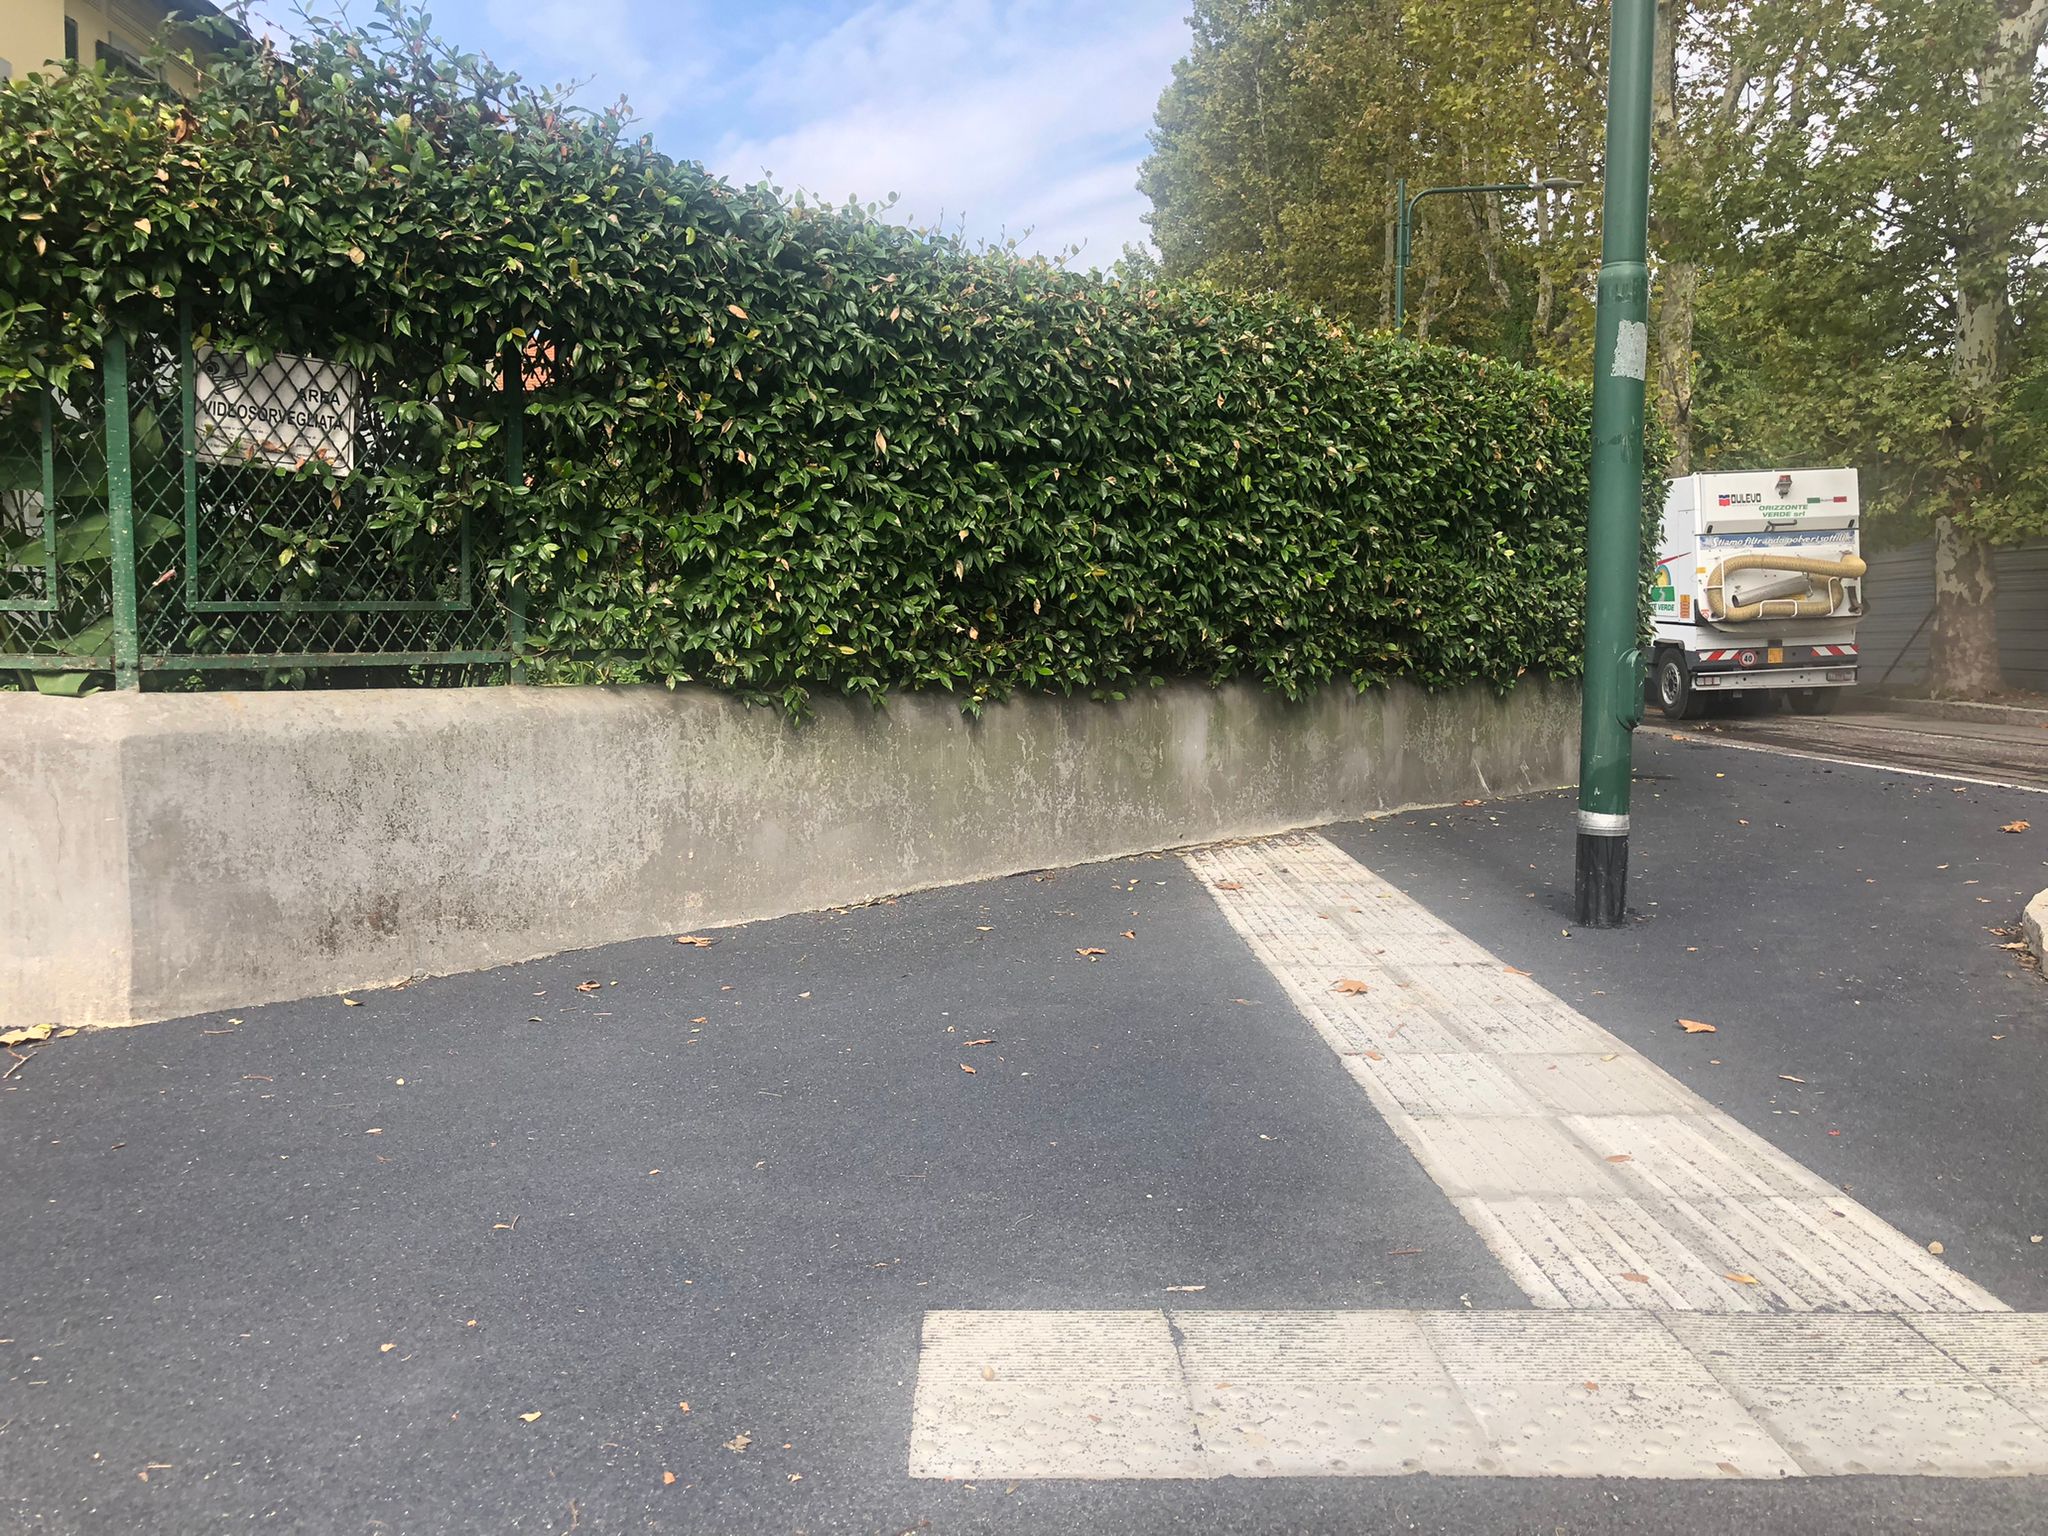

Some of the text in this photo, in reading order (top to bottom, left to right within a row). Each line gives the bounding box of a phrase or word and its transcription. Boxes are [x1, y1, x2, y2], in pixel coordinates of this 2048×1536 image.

[299, 388, 341, 406] AREA
[206, 400, 343, 431] VIDEOSORVEGLIATA
[1730, 493, 1762, 504] DULEVO
[1711, 536, 1743, 547] Stiamo
